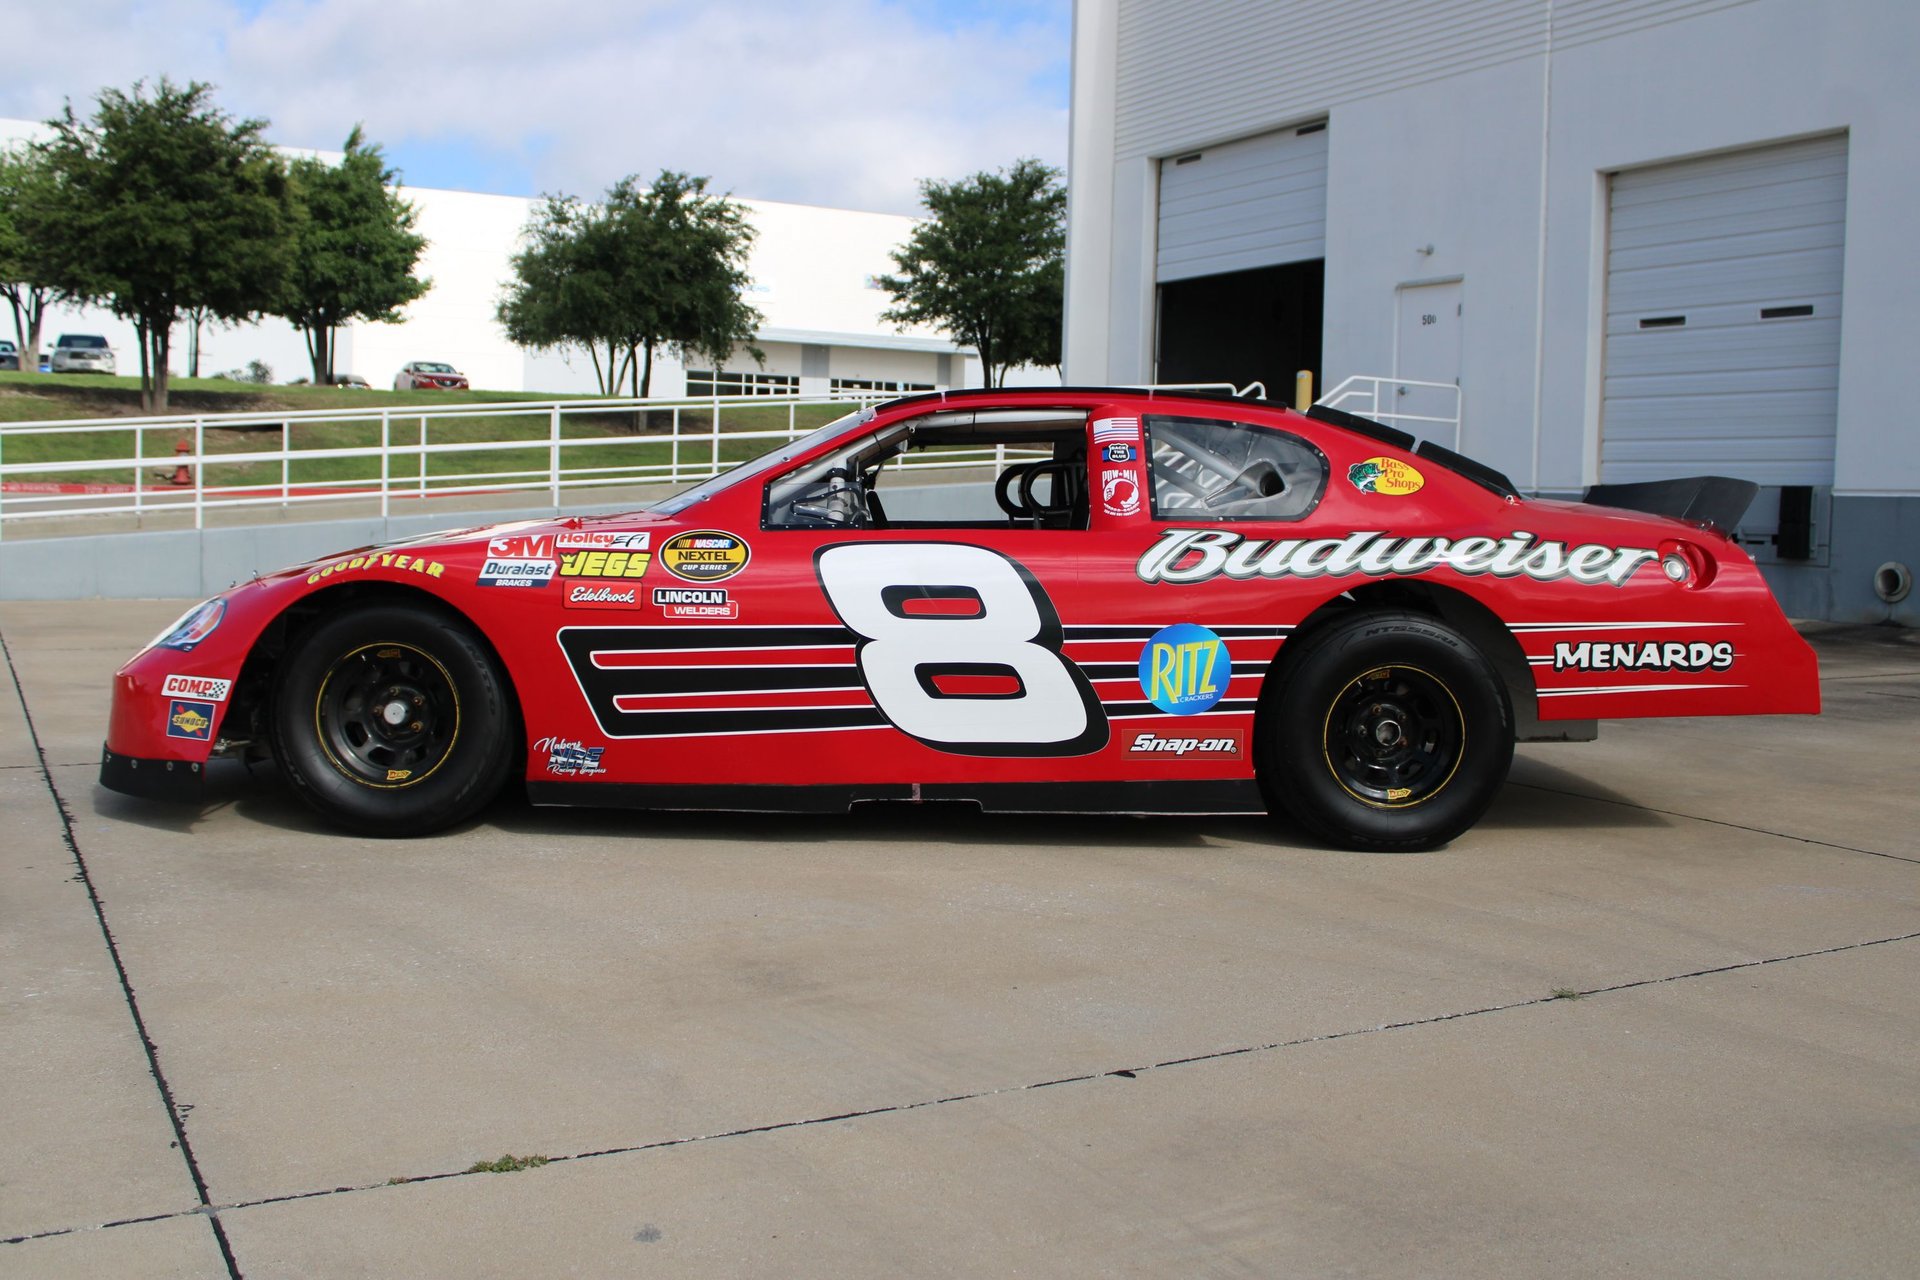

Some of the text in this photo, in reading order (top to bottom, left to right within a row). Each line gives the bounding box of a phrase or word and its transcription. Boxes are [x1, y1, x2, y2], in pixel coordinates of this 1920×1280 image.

[1422, 314, 1437, 325] 500
[1381, 458, 1409, 470] Bass
[1384, 468, 1404, 478] Pro
[1386, 478, 1421, 490] Shops
[490, 535, 552, 557] 3M
[560, 533, 645, 547] Holley EFI
[693, 539, 731, 548] NASCAR
[678, 551, 731, 561] NEXTEL
[1136, 528, 1660, 588] Budweiser
[307, 551, 445, 585] GOODYEAR
[485, 562, 552, 576] Duralast
[560, 551, 652, 577] JEGS
[495, 579, 532, 587] BRAKES
[569, 586, 635, 603] Edelbrock
[657, 591, 722, 603] LINCOLN
[674, 606, 731, 615] WELDERS
[813, 540, 1110, 758] 8
[1554, 641, 1734, 672] MENARDS
[1150, 640, 1220, 704] RITZ
[167, 678, 213, 693] COMP
[1180, 693, 1214, 703] CRACKERS
[173, 716, 206, 727] SUNOCO
[534, 737, 582, 752] Nabors
[1130, 734, 1234, 755] Snap-on
[547, 764, 607, 777] Racing Engines
